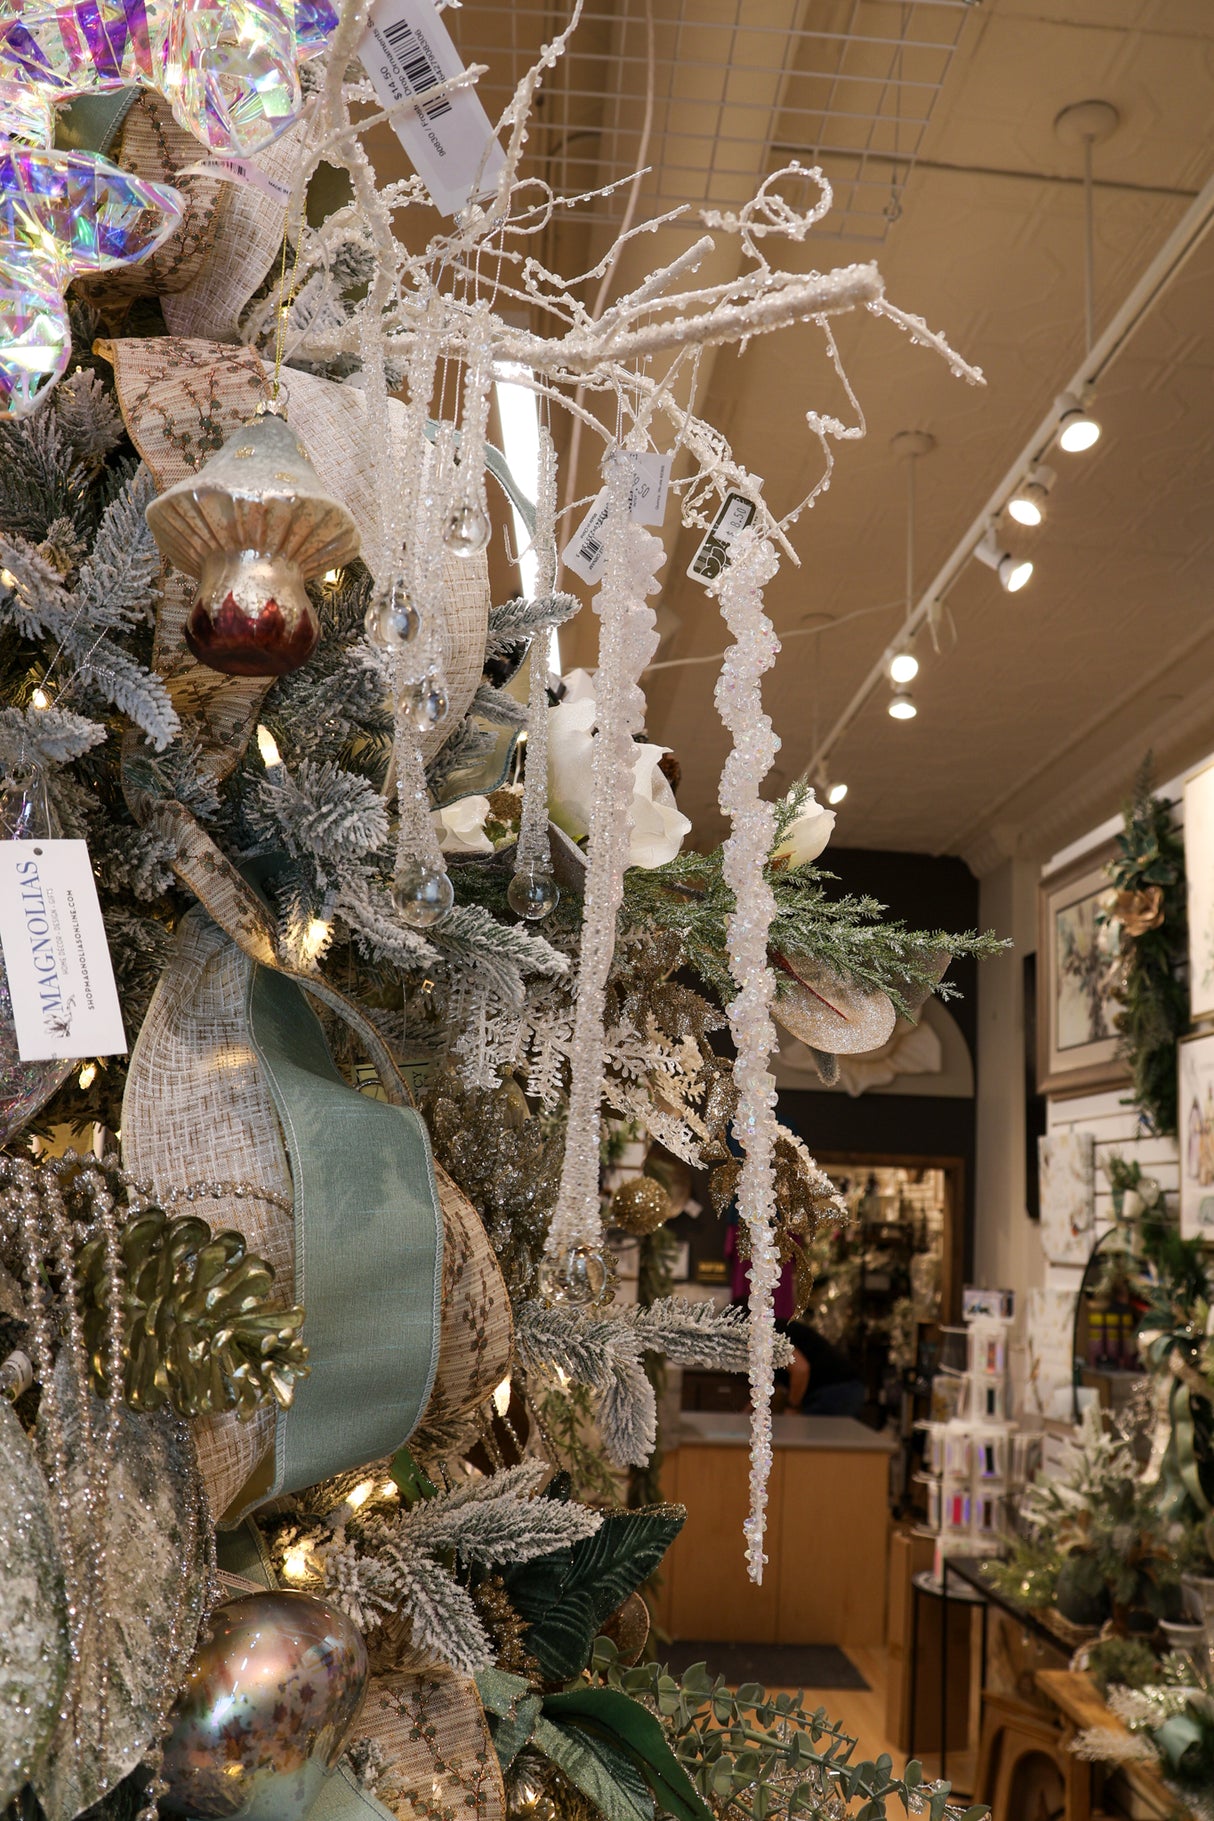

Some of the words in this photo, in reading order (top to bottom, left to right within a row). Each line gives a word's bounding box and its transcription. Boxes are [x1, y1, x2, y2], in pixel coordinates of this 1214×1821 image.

[373, 28, 400, 76] Ornaments
[380, 66, 403, 101] $14.50
[398, 79, 412, 97] Drop
[428, 131, 447, 157] 90830
[730, 507, 747, 529] 8.50
[47, 888, 56, 905] GIFTS
[53, 907, 61, 930] DESIGN
[16, 861, 64, 1013] MAGNOLIAS
[67, 889, 95, 1010] SHOPMAGNOLIASONLINE.COM
[61, 957, 69, 974] HOME
